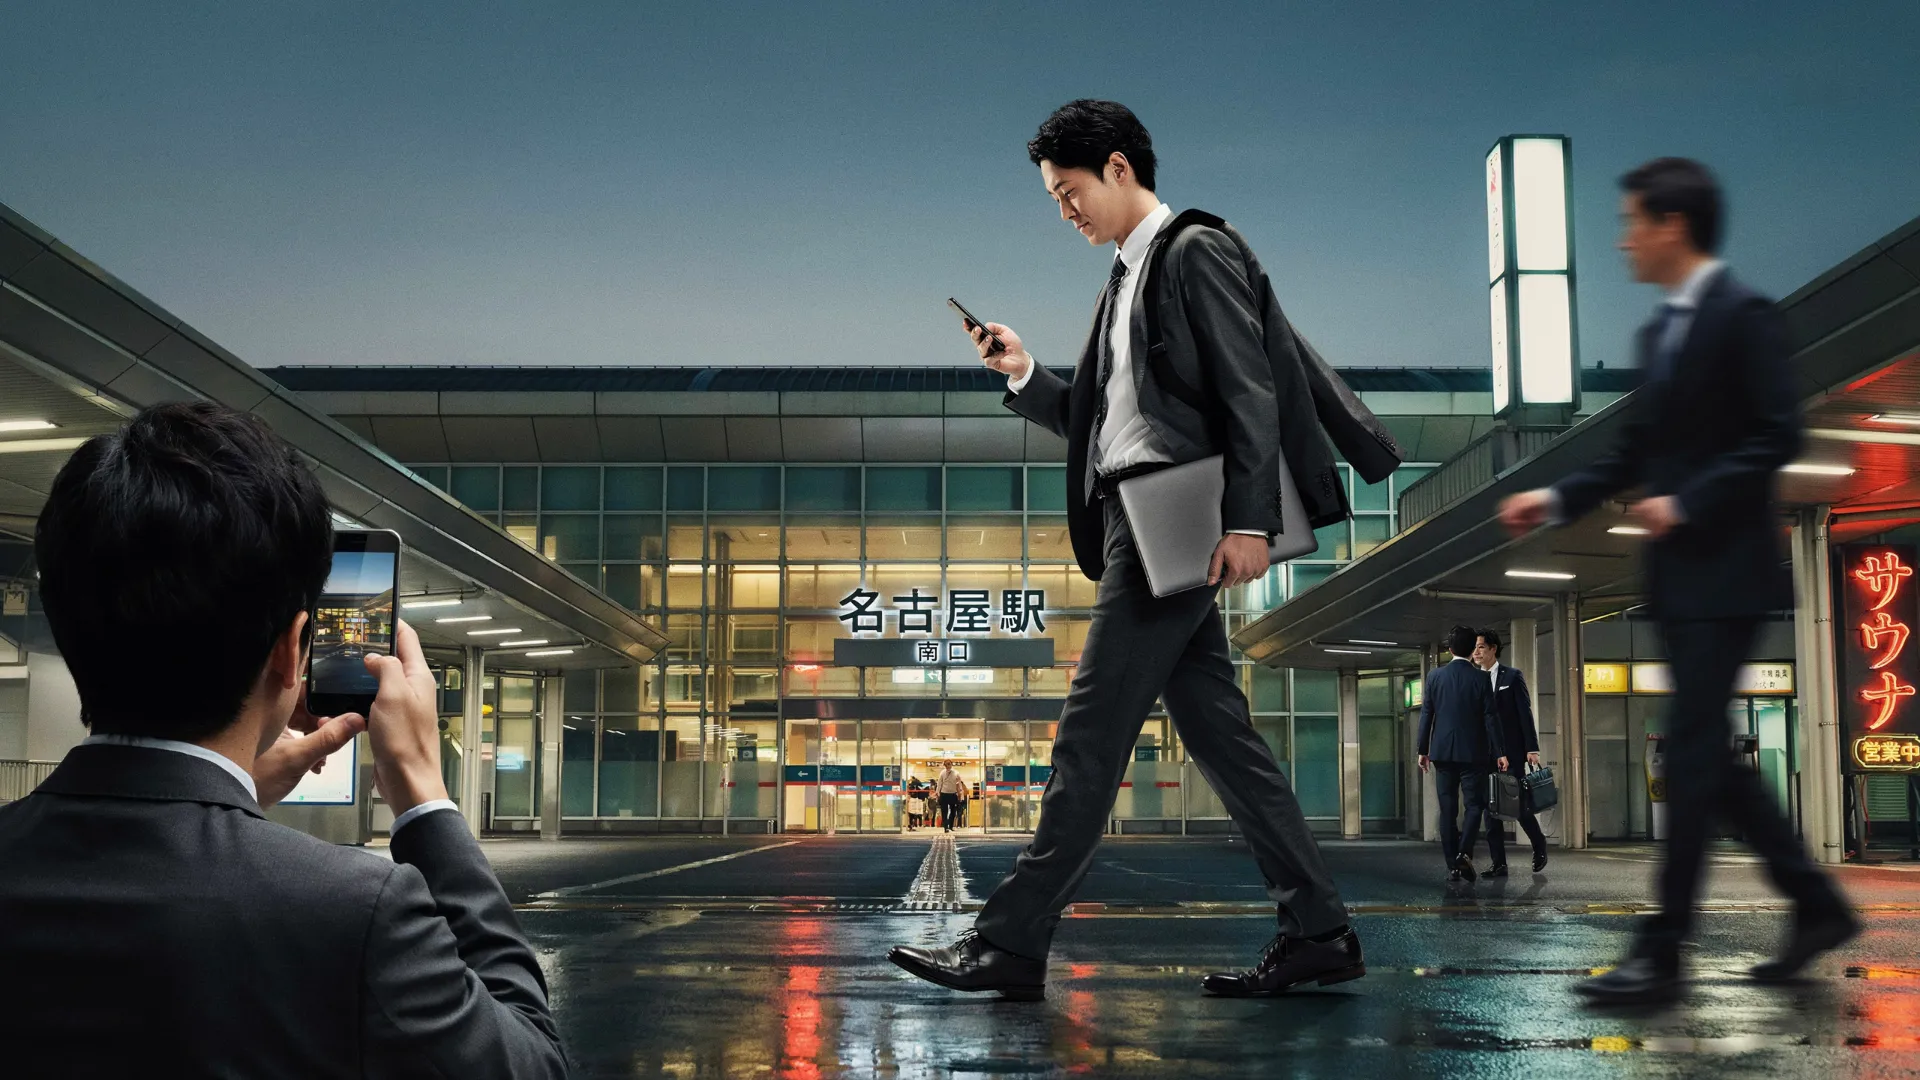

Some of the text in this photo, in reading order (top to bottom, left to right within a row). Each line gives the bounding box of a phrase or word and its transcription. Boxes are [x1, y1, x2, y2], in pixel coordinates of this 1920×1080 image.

[838, 587, 1046, 634] 名古屋駅
[917, 641, 968, 662] 南口
[1855, 552, 1916, 730] サウナ
[1861, 741, 1920, 762] 営業中
